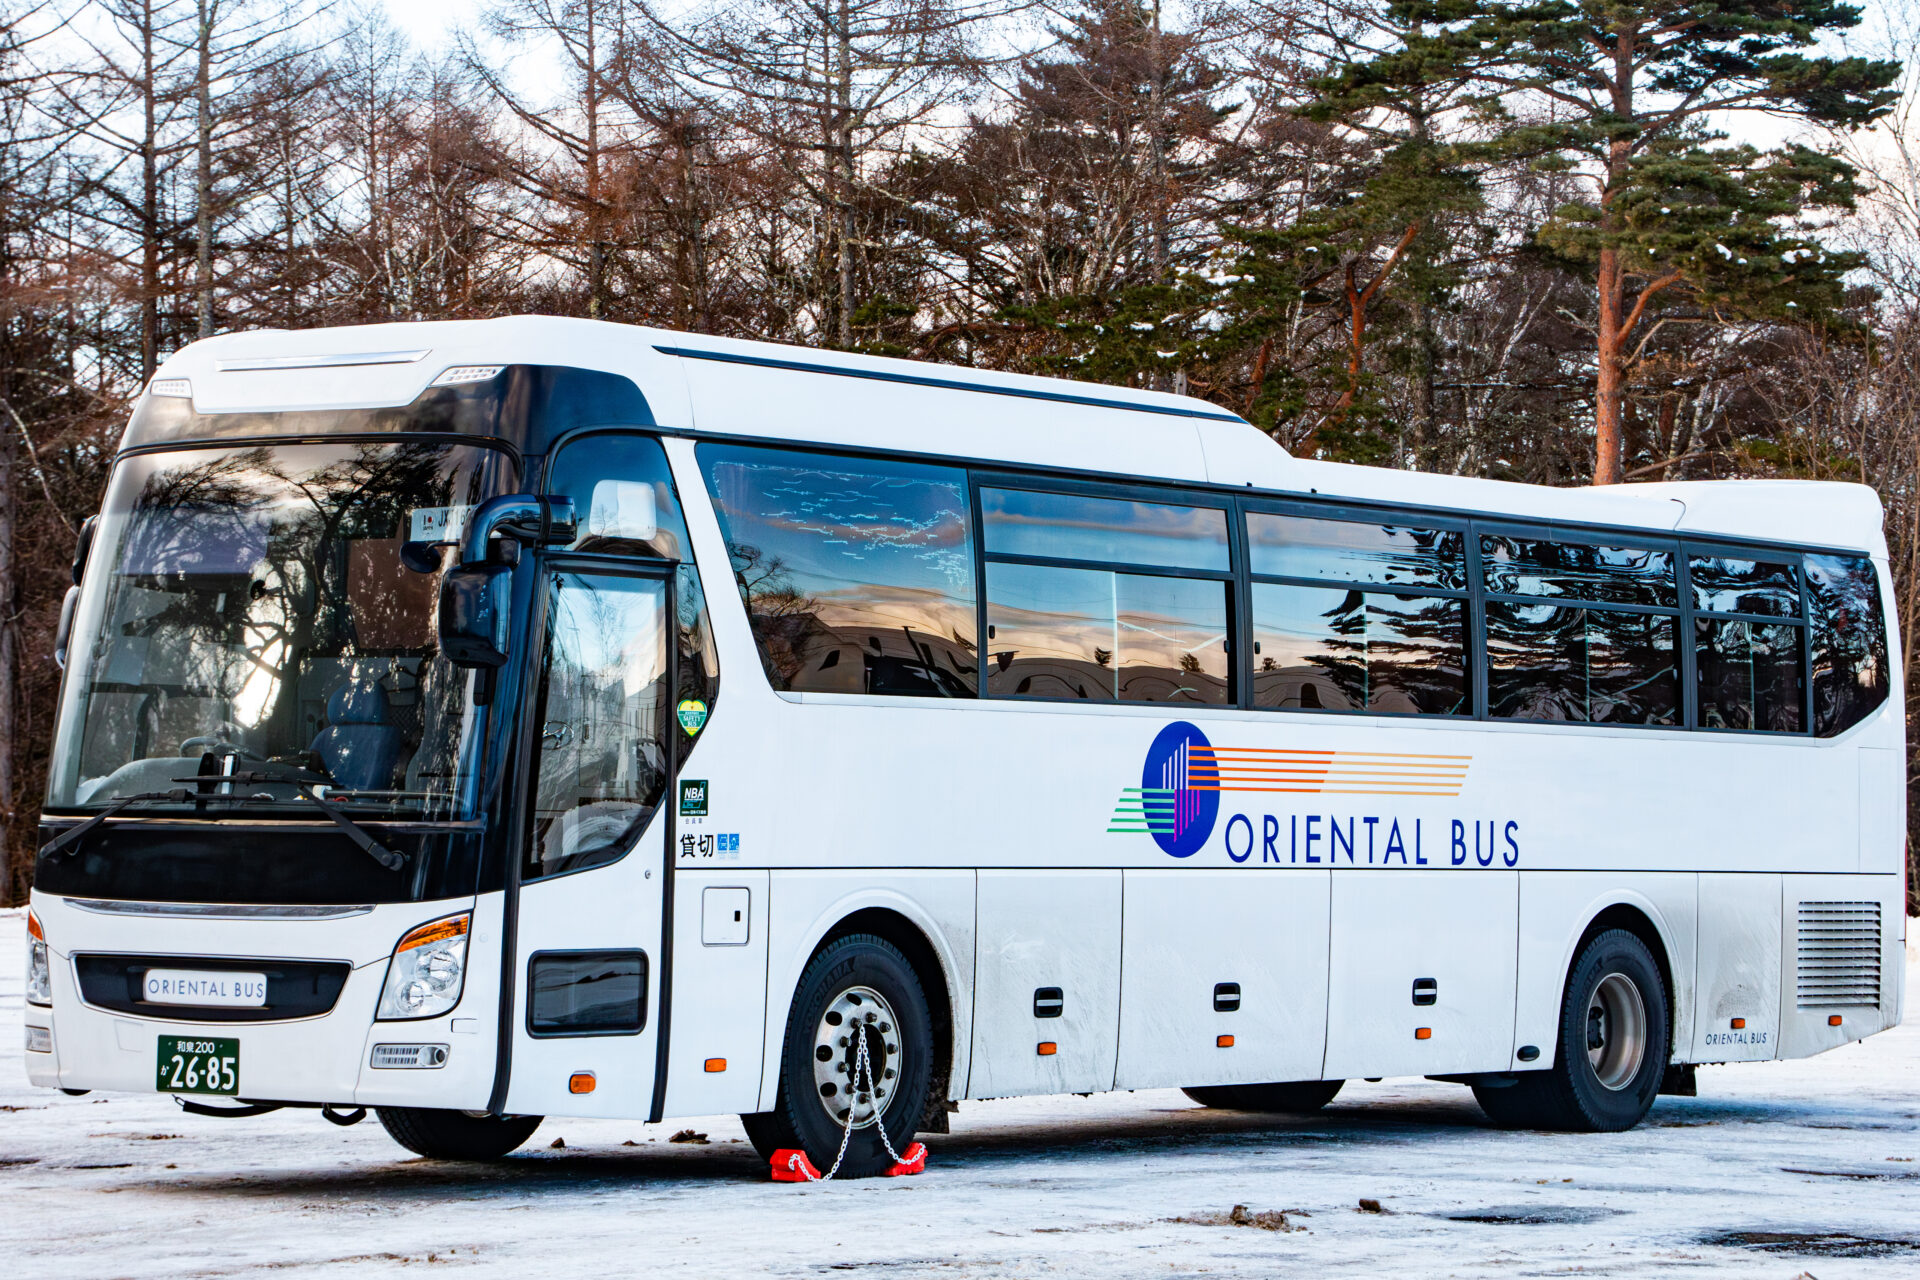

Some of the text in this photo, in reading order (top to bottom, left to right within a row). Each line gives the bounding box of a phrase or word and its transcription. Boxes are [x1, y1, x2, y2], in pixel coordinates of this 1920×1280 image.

[684, 787, 704, 800] NBA
[680, 833, 714, 858] 貸切
[1225, 812, 1520, 867] ORIENTAL BUS
[148, 979, 264, 998] ORIENTAL BUS
[177, 1041, 215, 1054] 和泉200
[1705, 1032, 1767, 1045] ORIENTAL BUS
[159, 1054, 236, 1091] か 26-85
